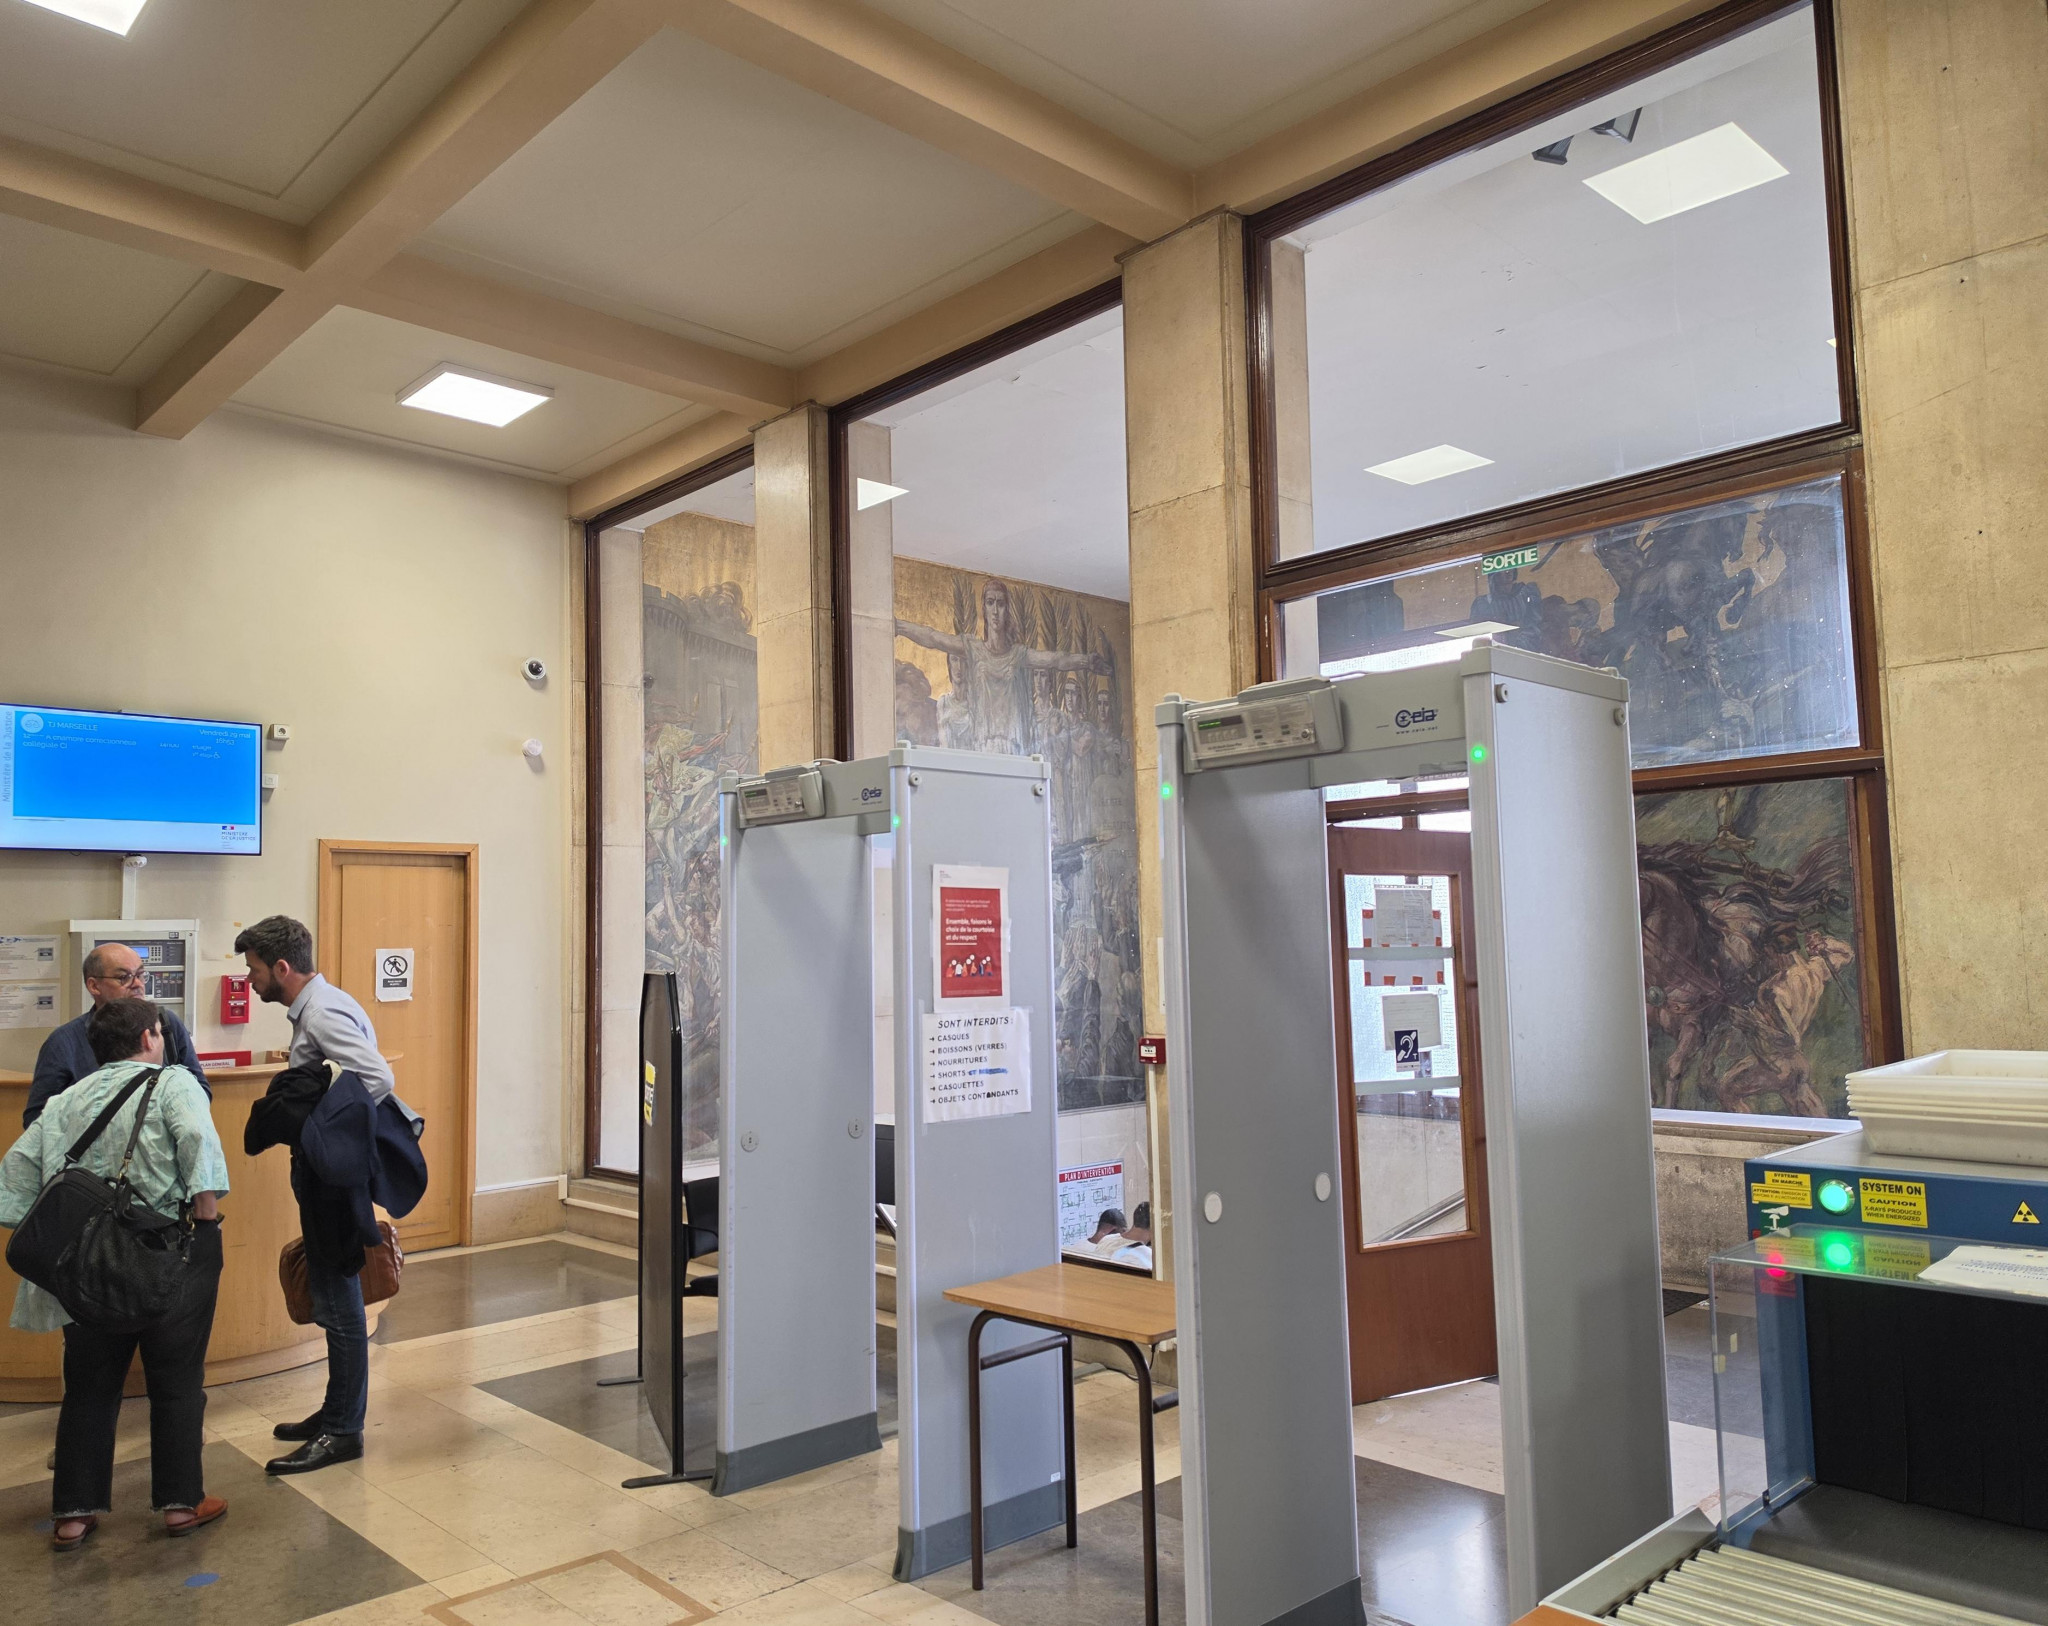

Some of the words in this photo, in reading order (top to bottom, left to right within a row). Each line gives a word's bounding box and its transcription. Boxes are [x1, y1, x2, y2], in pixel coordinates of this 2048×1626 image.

[1482, 548, 1538, 571] SORTIE
[4, 711, 12, 740] Justice
[56, 721, 98, 732] MARSEILLE
[200, 728, 228, 738] Vendredi
[3, 742, 12, 750] la
[3, 751, 12, 761] de
[938, 1020, 962, 1028] SONT
[964, 1016, 1009, 1026] INTERDITS
[938, 1033, 970, 1042] CASQUES
[938, 1044, 972, 1054] BOISSONS
[974, 1042, 1007, 1052] (VERRES)
[938, 1056, 988, 1066] NOURRITURES
[938, 1070, 966, 1078] SHORTS
[938, 1080, 984, 1091] CASQUETTES
[938, 1094, 966, 1104] OBJETS
[1064, 1172, 1076, 1181] PLAN
[1077, 1166, 1115, 1180] D'INTERVENTION
[1862, 1182, 1903, 1194] SYSTEM
[1906, 1186, 1921, 1195] ON
[1869, 1198, 1916, 1207] CAUTION
[1887, 1208, 1922, 1216] PRODUCED
